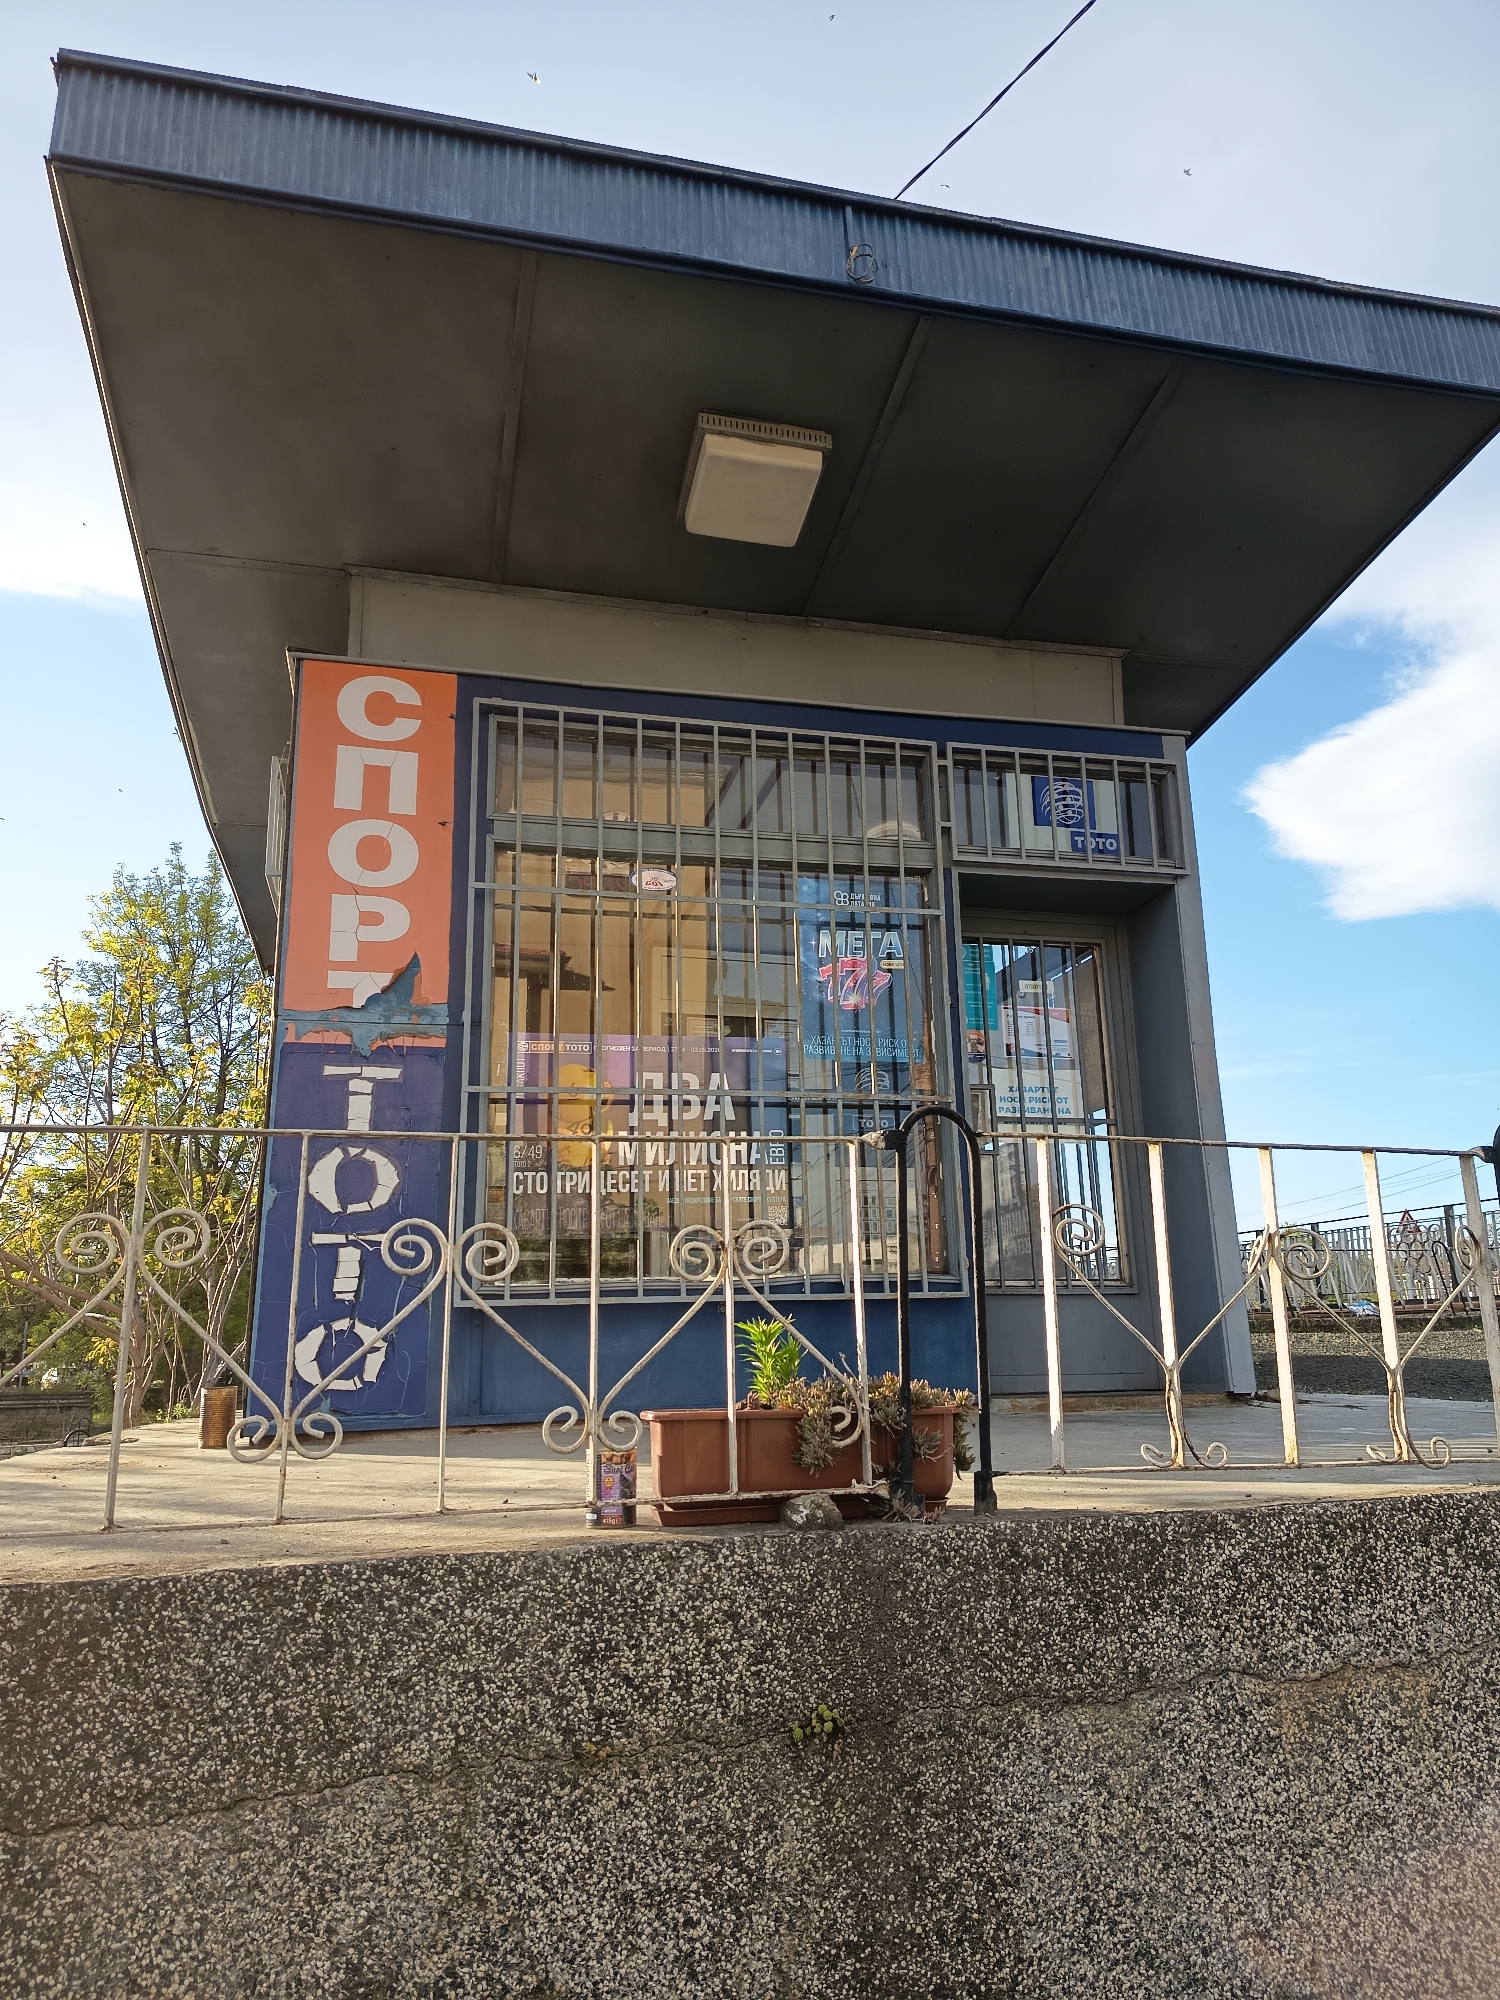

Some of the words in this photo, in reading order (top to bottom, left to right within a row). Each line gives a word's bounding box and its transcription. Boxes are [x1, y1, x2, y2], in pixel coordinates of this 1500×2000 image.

[1074, 836, 1118, 851] ТОТО
[850, 893, 881, 901] ДЪРВНА
[818, 929, 904, 958] МЕГА
[811, 1035, 852, 1047] ХАЗАЪТ
[853, 1036, 872, 1047] НОС
[878, 1038, 900, 1048] РИСК
[803, 1045, 852, 1056] РАЗВИВНЕ
[853, 1046, 865, 1056] НА
[866, 1047, 920, 1058] ЗВИСИМОСТ
[628, 1071, 737, 1127] ДВА
[999, 1096, 1026, 1104] НОС
[998, 1106, 1053, 1115] РАЗИВАН
[1057, 1107, 1072, 1115] НА
[859, 1118, 889, 1128] ТОО
[513, 1144, 543, 1159] 6/49
[617, 1130, 769, 1166] МИЛИОНА
[513, 1171, 549, 1195] СТО
[294, 1064, 403, 1391] ТОТО
